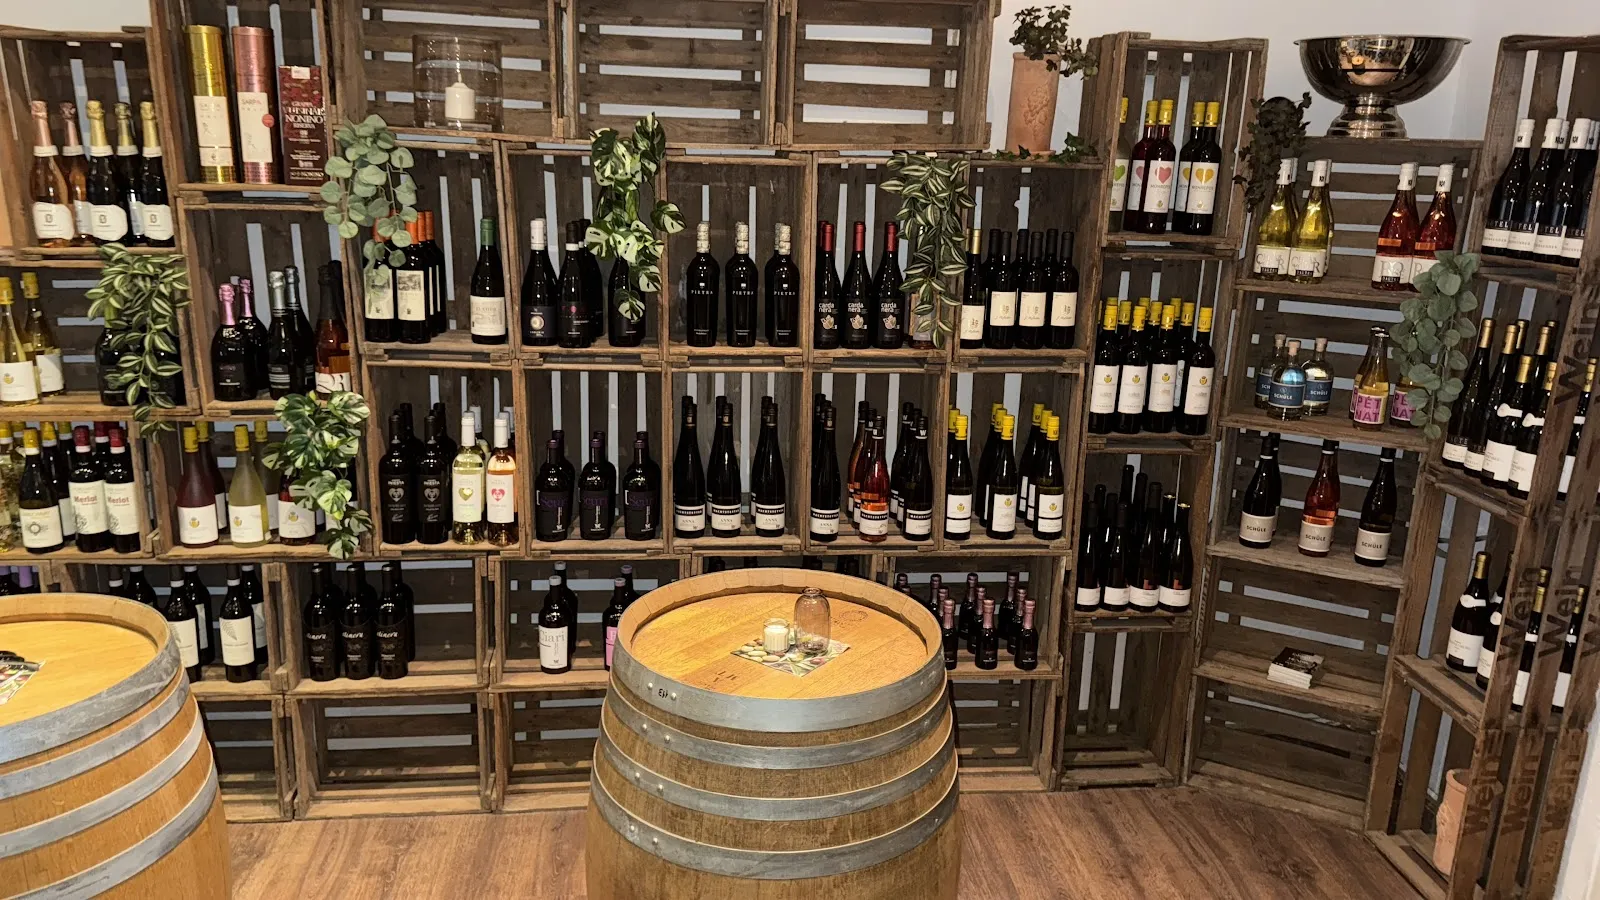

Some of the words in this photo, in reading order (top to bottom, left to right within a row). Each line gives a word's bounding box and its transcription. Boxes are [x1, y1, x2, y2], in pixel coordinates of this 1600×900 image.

[285, 114, 324, 124] NONINO
[1305, 534, 1326, 542] SCHÜLE
[1361, 541, 1382, 549] SCHÜLE
